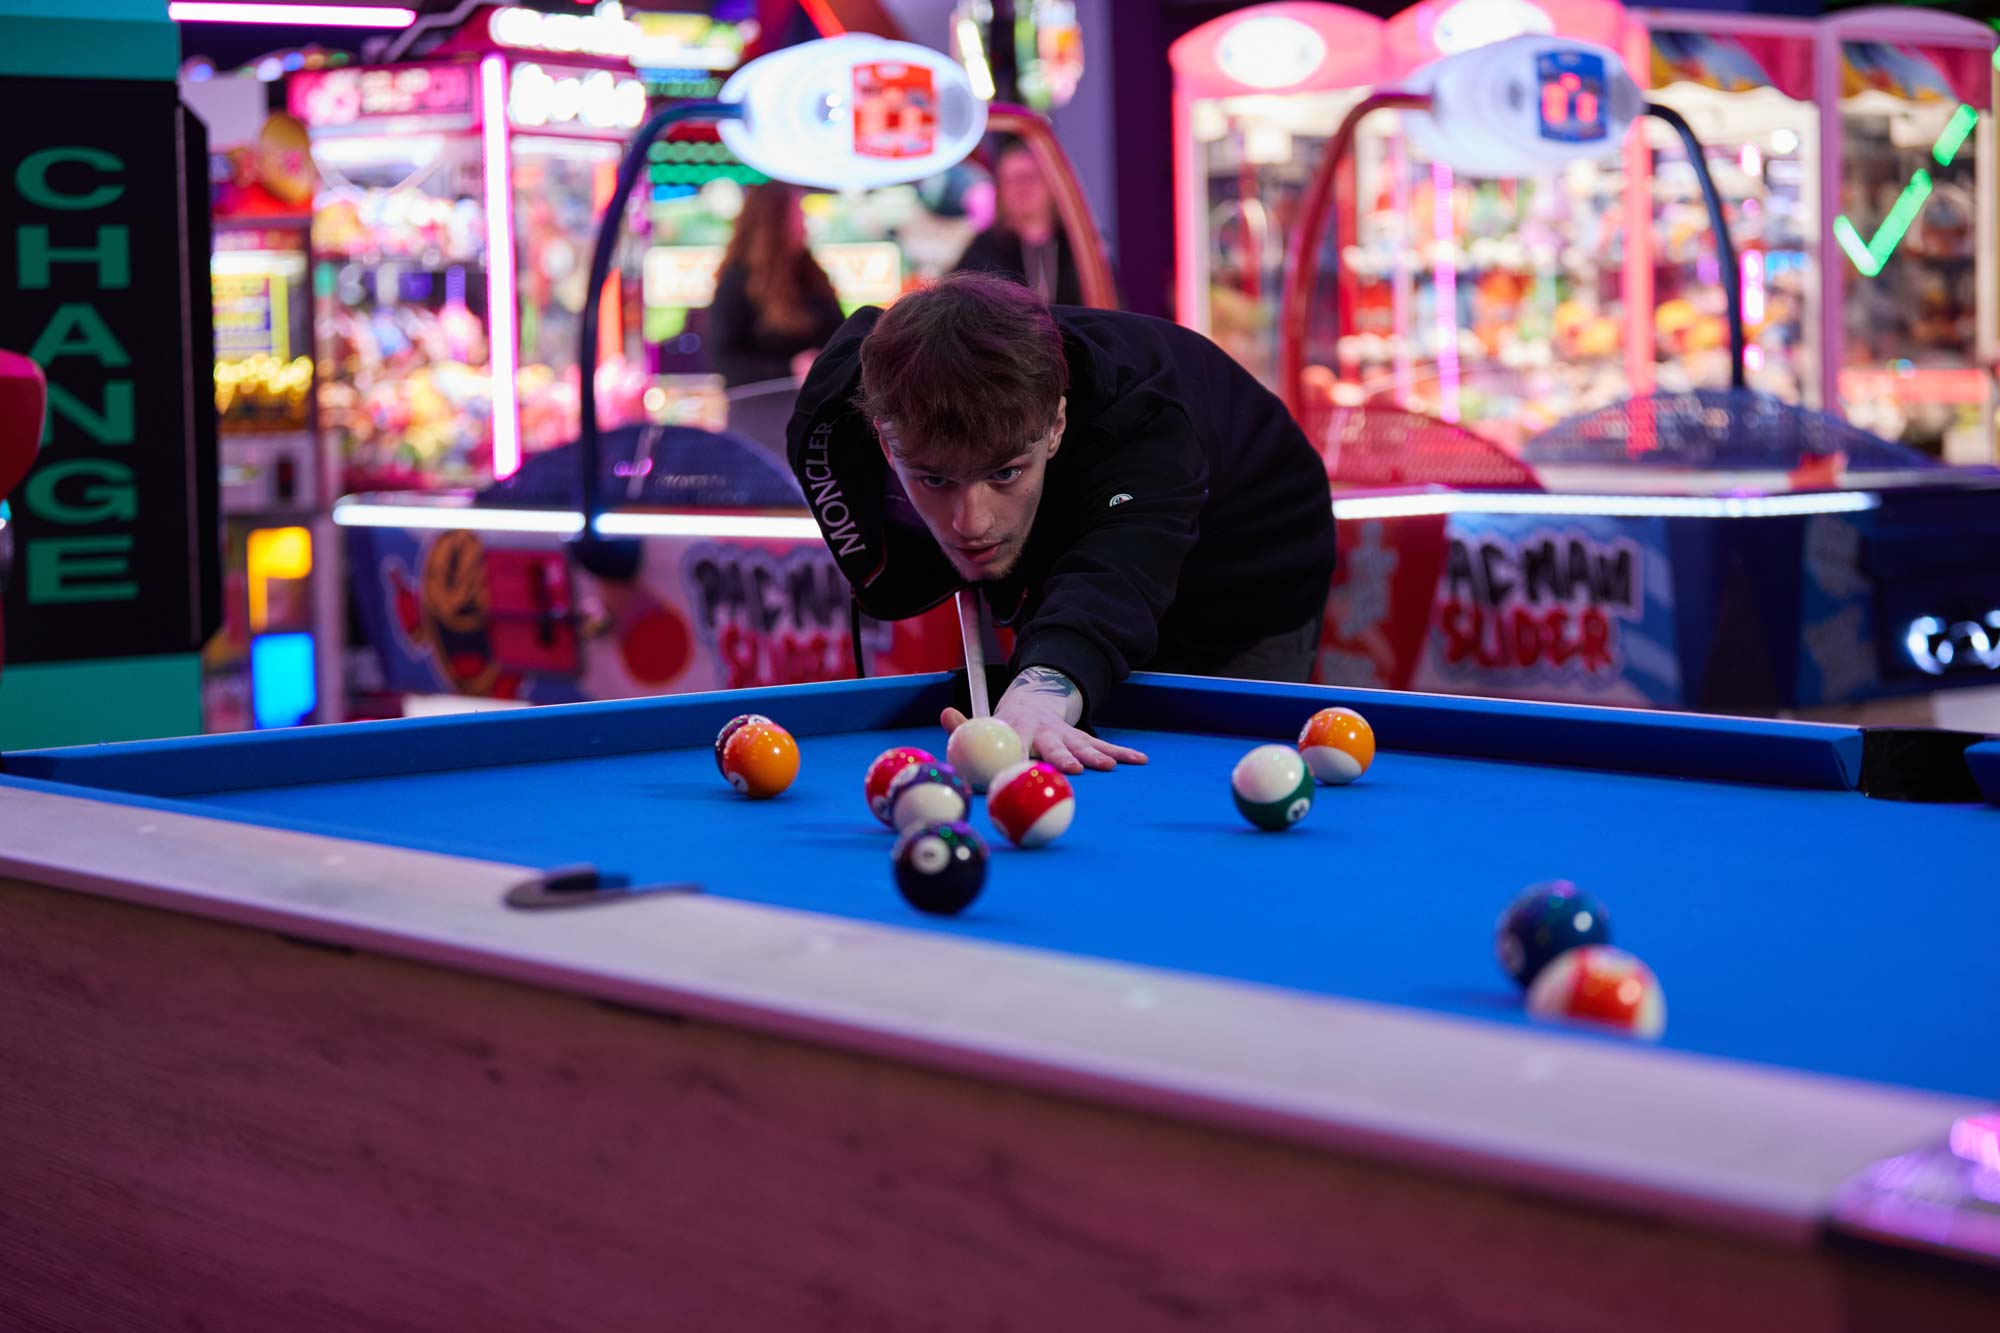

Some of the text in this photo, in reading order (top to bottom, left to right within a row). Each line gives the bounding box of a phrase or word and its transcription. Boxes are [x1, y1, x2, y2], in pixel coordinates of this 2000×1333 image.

[15, 146, 139, 604] CHANGE
[806, 419, 867, 558] MONCLER
[1442, 597, 1612, 673] SLIDER
